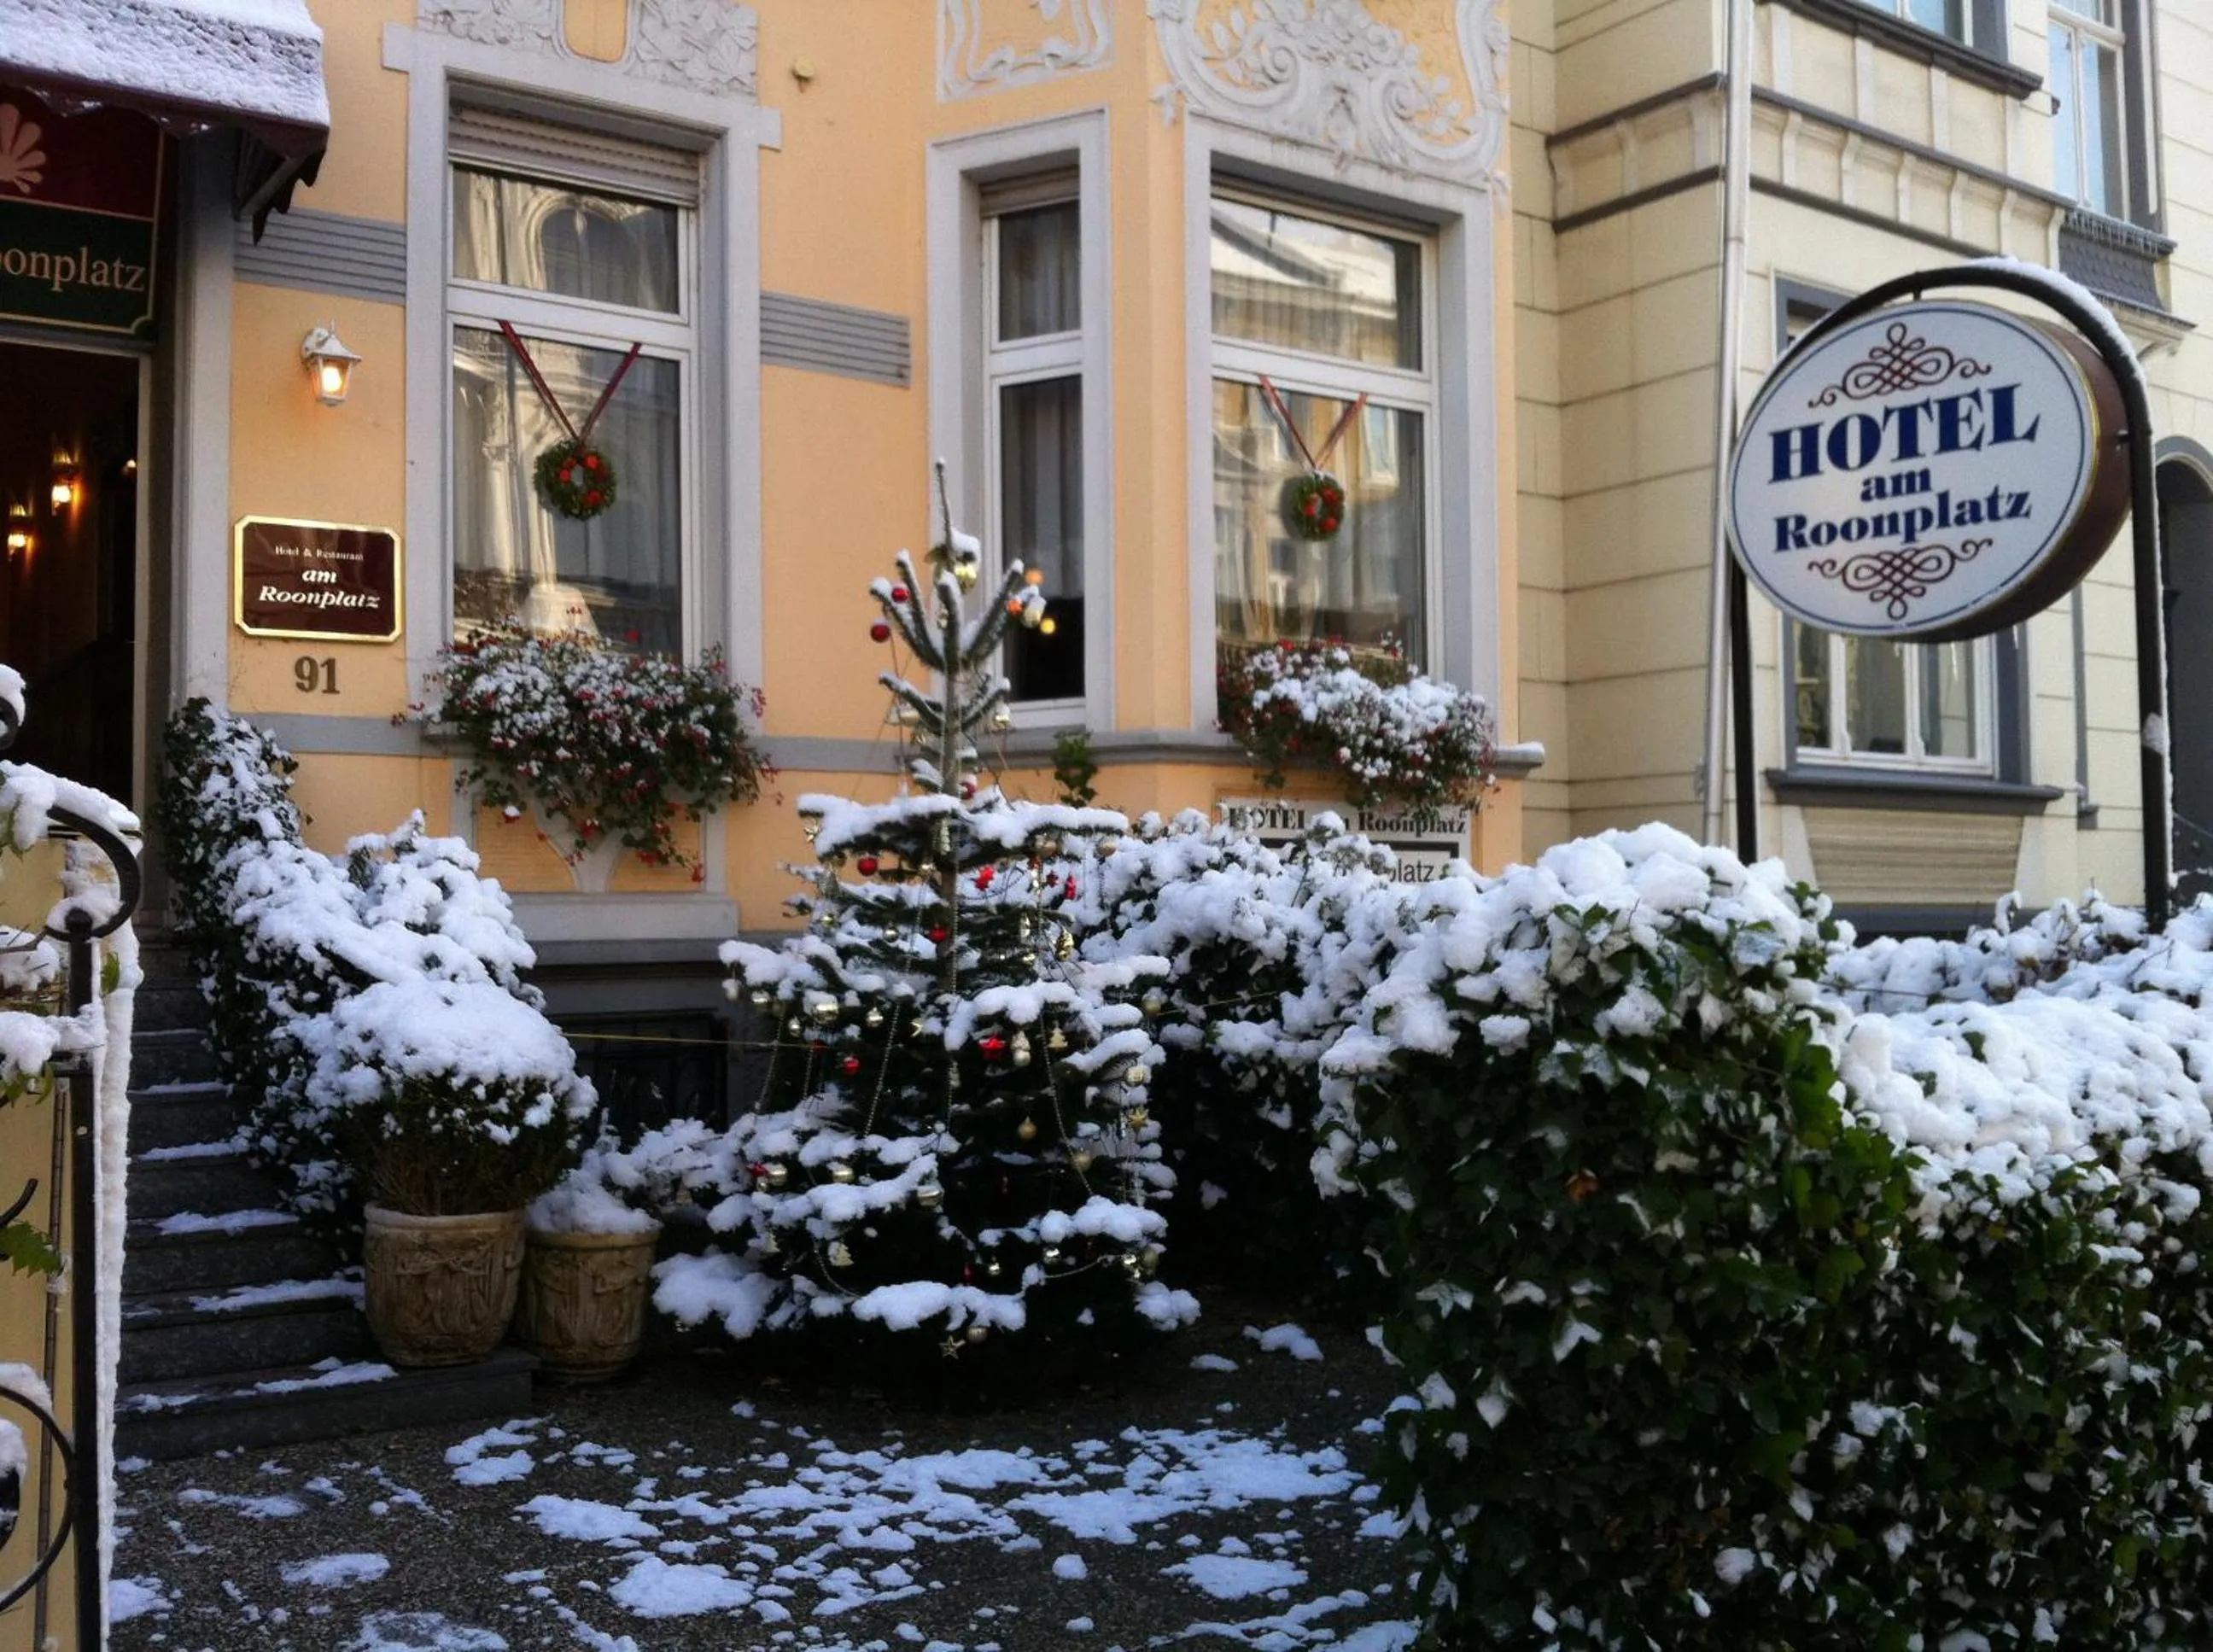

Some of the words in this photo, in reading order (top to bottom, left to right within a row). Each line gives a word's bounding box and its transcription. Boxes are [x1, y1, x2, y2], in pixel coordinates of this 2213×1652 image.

[0, 247, 146, 293] onplatz
[1768, 383, 2041, 484] HOTEL
[1860, 467, 1933, 502] am
[1773, 483, 2032, 553] Roonplatz
[275, 546, 299, 556] Hotel
[301, 569, 337, 583] am
[259, 586, 381, 610] Roonplatz
[295, 656, 340, 694] 91
[1359, 811, 1466, 838] Roonplatz
